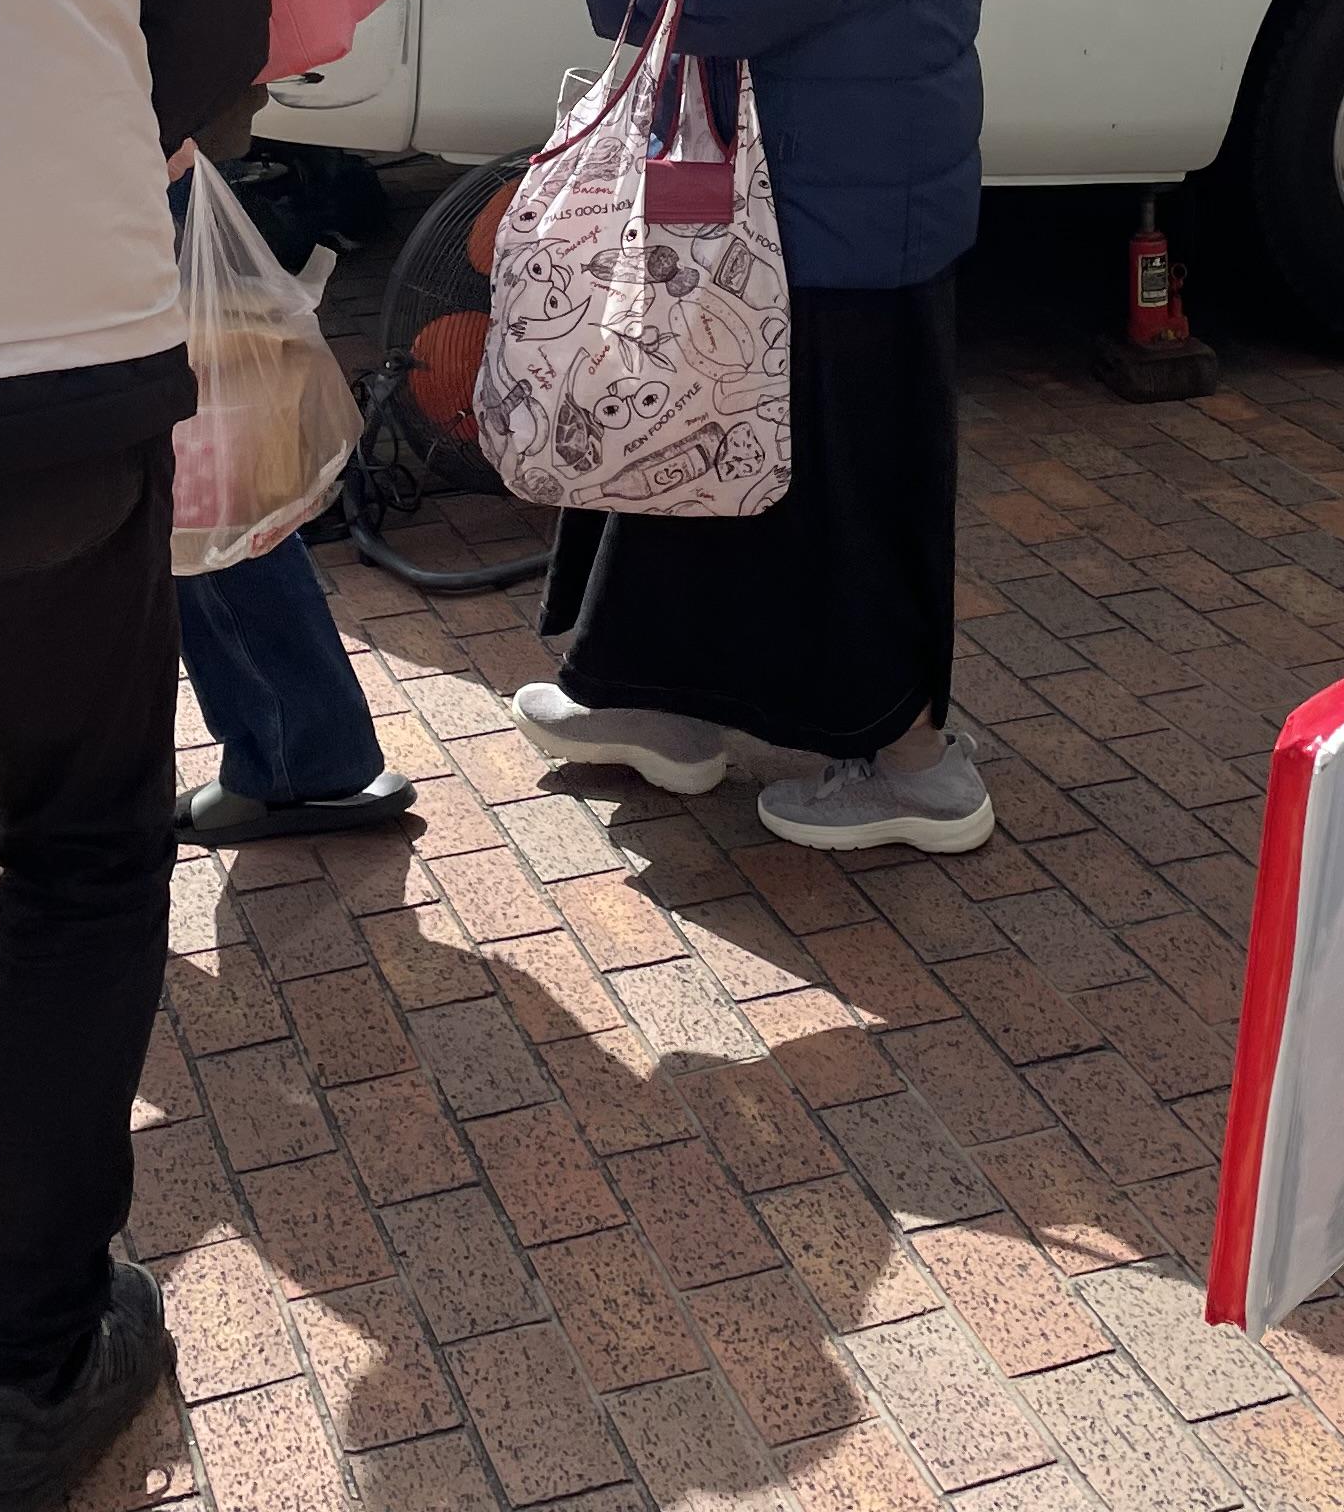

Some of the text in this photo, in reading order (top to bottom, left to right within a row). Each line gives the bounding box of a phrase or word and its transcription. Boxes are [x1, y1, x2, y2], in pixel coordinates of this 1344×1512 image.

[574, 203, 608, 217] FOOD
[649, 404, 680, 434] FOOD
[674, 381, 703, 413] STYLE
